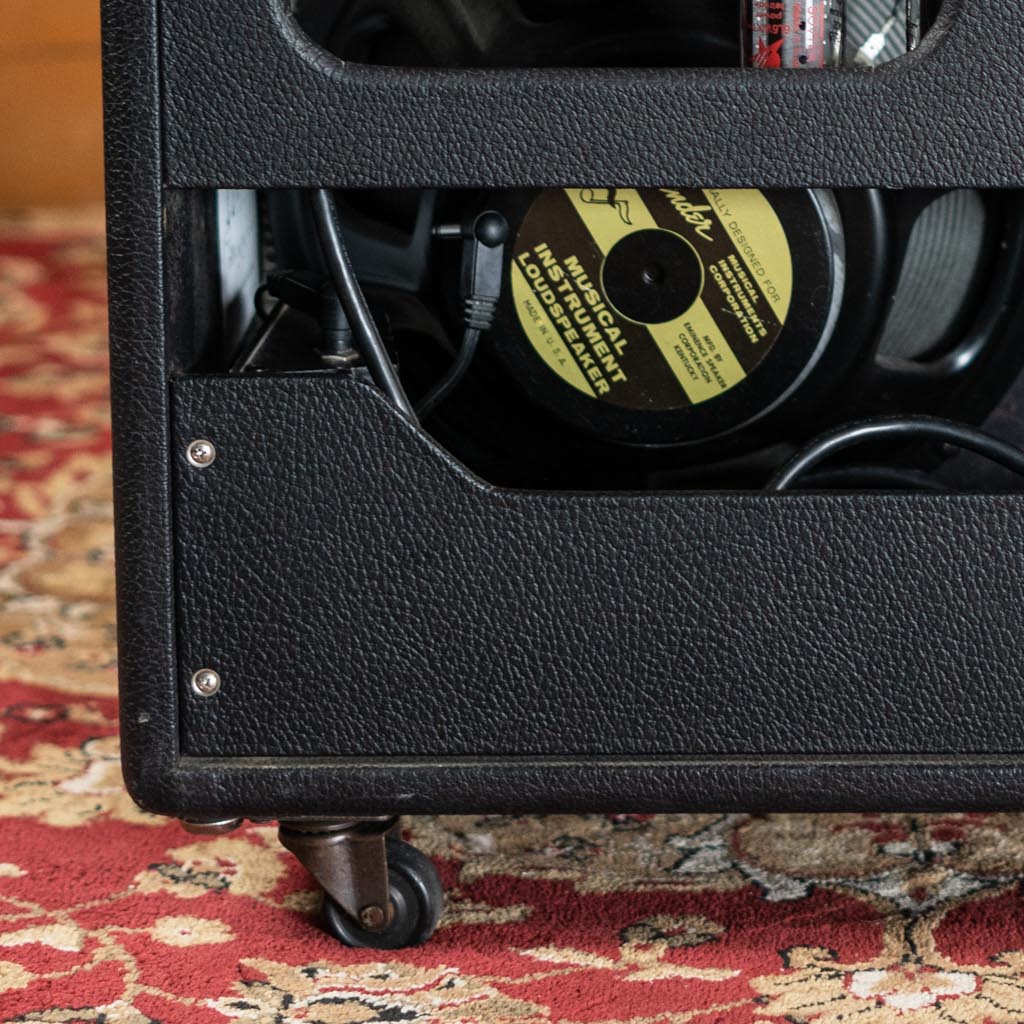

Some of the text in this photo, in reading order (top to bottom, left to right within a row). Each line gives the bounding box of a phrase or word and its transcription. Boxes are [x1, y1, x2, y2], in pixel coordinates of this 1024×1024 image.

[718, 259, 768, 336] INSTRUMENTS
[728, 220, 765, 277] DESIGNED
[764, 279, 781, 303] FOR
[728, 254, 760, 304] MUSICAL
[517, 252, 610, 395] LOUDSPEAKER
[523, 299, 541, 322] MADE
[534, 242, 627, 383] INSTRUMENT
[564, 255, 627, 356] MUSICAL
[709, 264, 759, 343] CORPORATION
